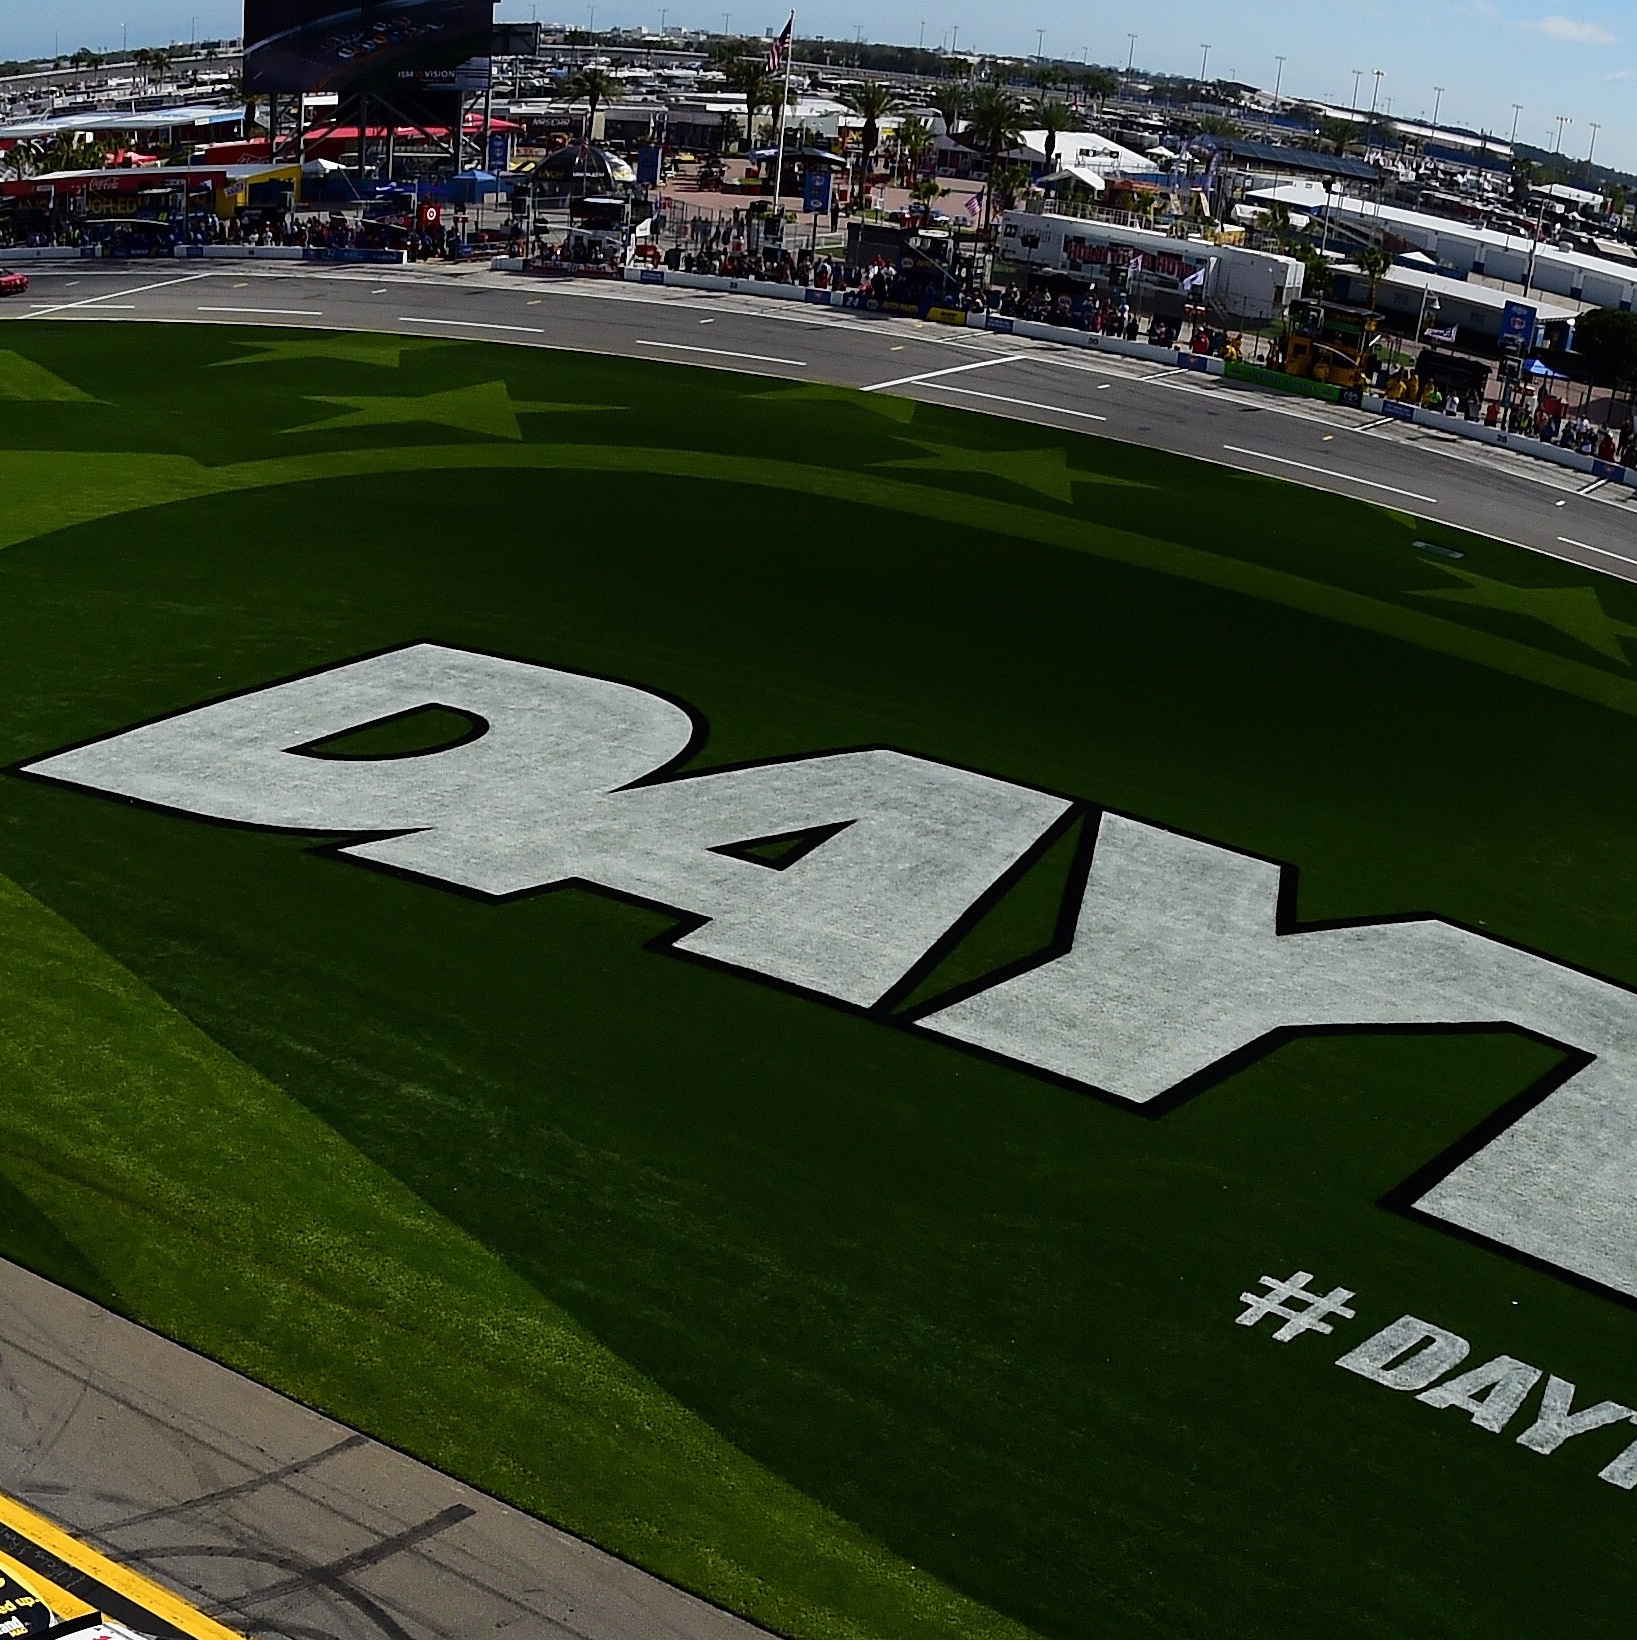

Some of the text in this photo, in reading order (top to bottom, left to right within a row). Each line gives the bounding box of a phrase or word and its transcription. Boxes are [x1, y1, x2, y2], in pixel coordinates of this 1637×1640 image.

[424, 70, 455, 79] VISION
[532, 117, 571, 128] NASCAR
[15, 1594, 42, 1614] up.
